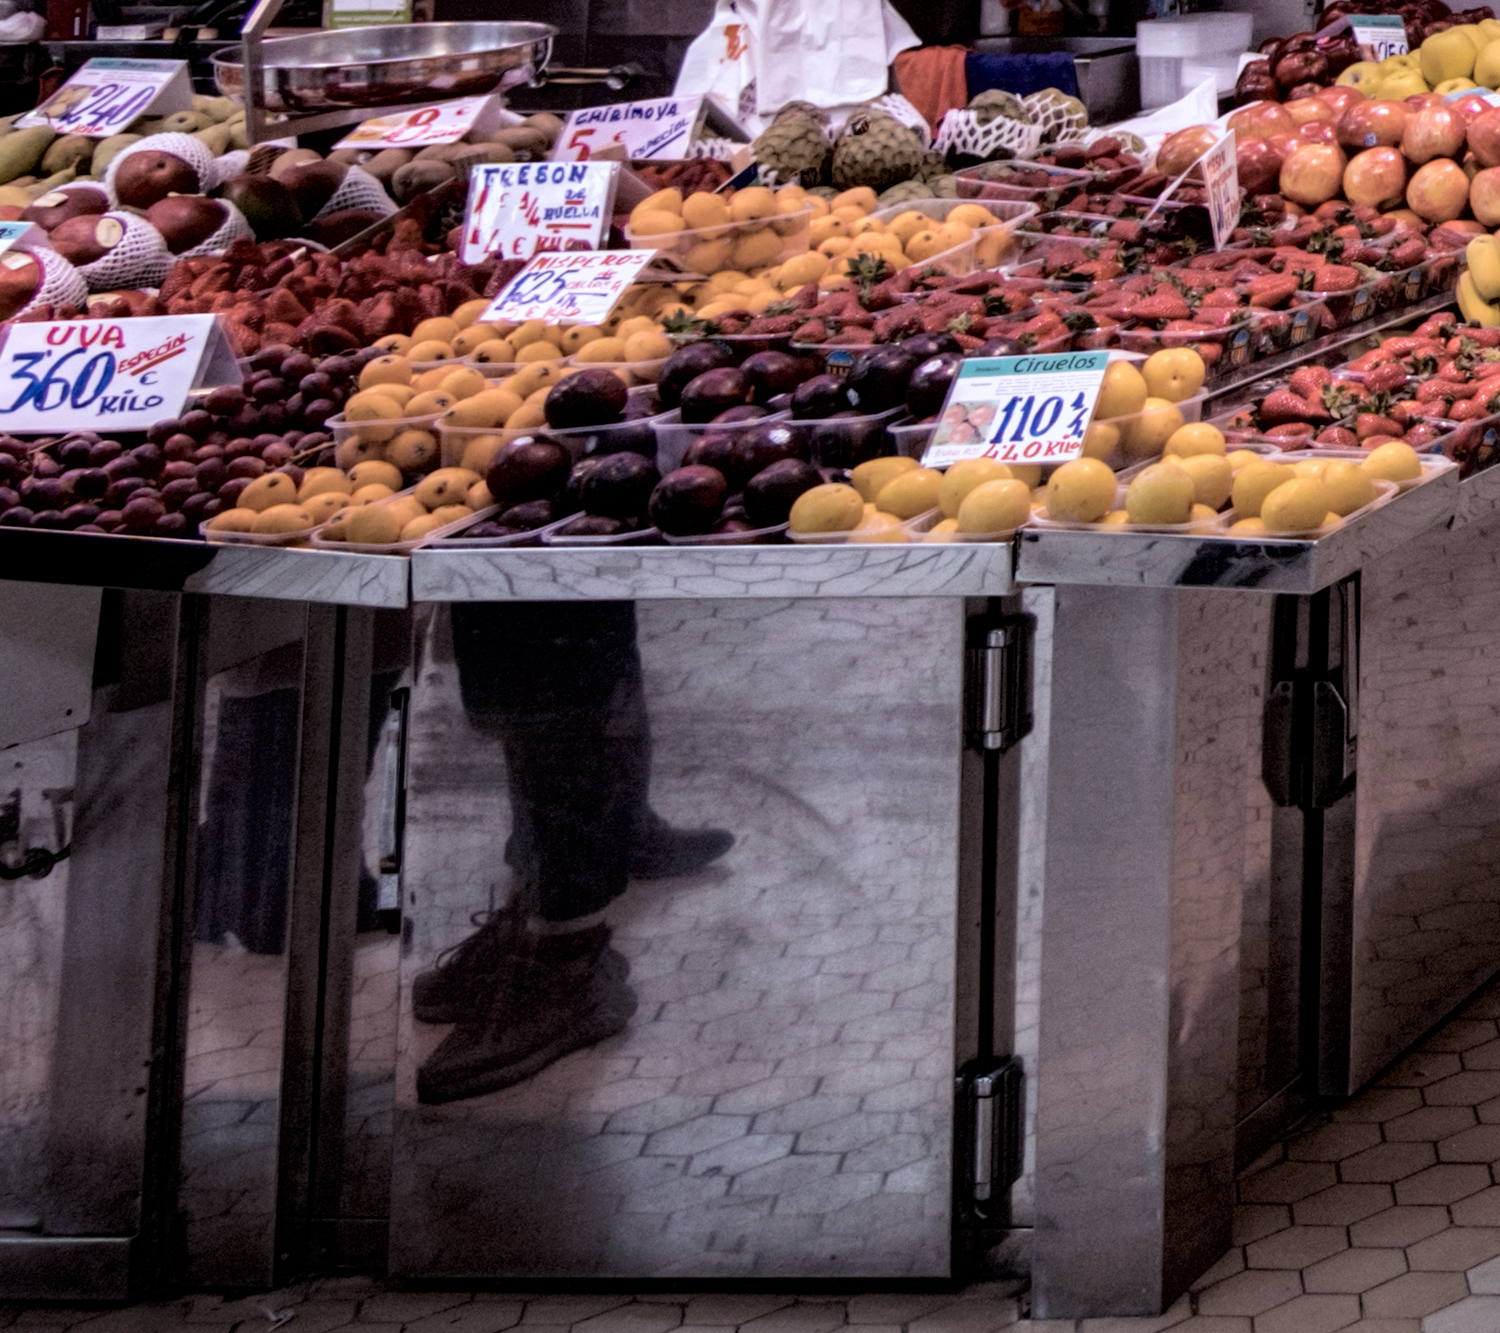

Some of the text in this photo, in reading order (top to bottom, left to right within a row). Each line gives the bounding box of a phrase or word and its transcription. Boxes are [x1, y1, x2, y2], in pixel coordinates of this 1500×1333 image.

[574, 102, 679, 126] CHIRIMOYA
[567, 128, 596, 161] 5
[527, 253, 645, 272] NISPEROS
[46, 323, 126, 349] UVA
[117, 332, 196, 374] ESPECIAL
[1013, 355, 1098, 374] Ciruelos
